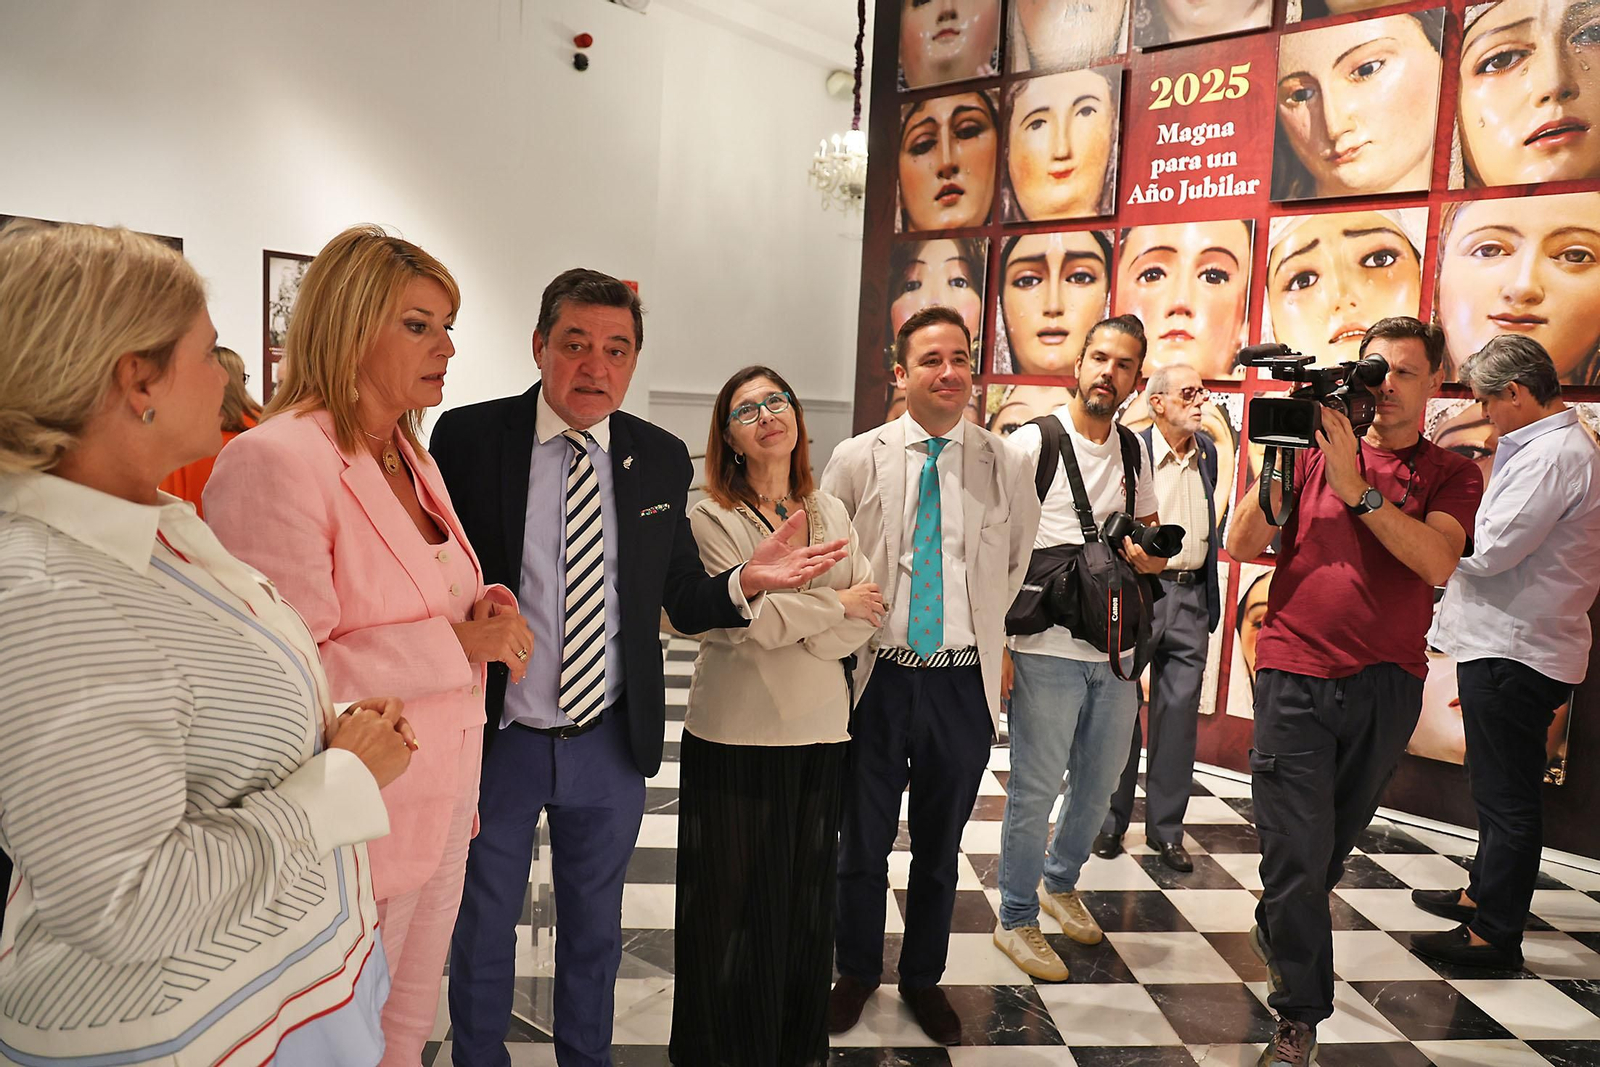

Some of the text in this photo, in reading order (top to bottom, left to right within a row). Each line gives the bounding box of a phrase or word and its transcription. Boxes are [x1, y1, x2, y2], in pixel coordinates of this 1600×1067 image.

[1148, 62, 1252, 110] 2025
[1156, 121, 1235, 146] Magna
[1150, 150, 1238, 180] para un
[1126, 173, 1261, 205] Año Jubilar
[1284, 449, 1292, 491] Panasonic
